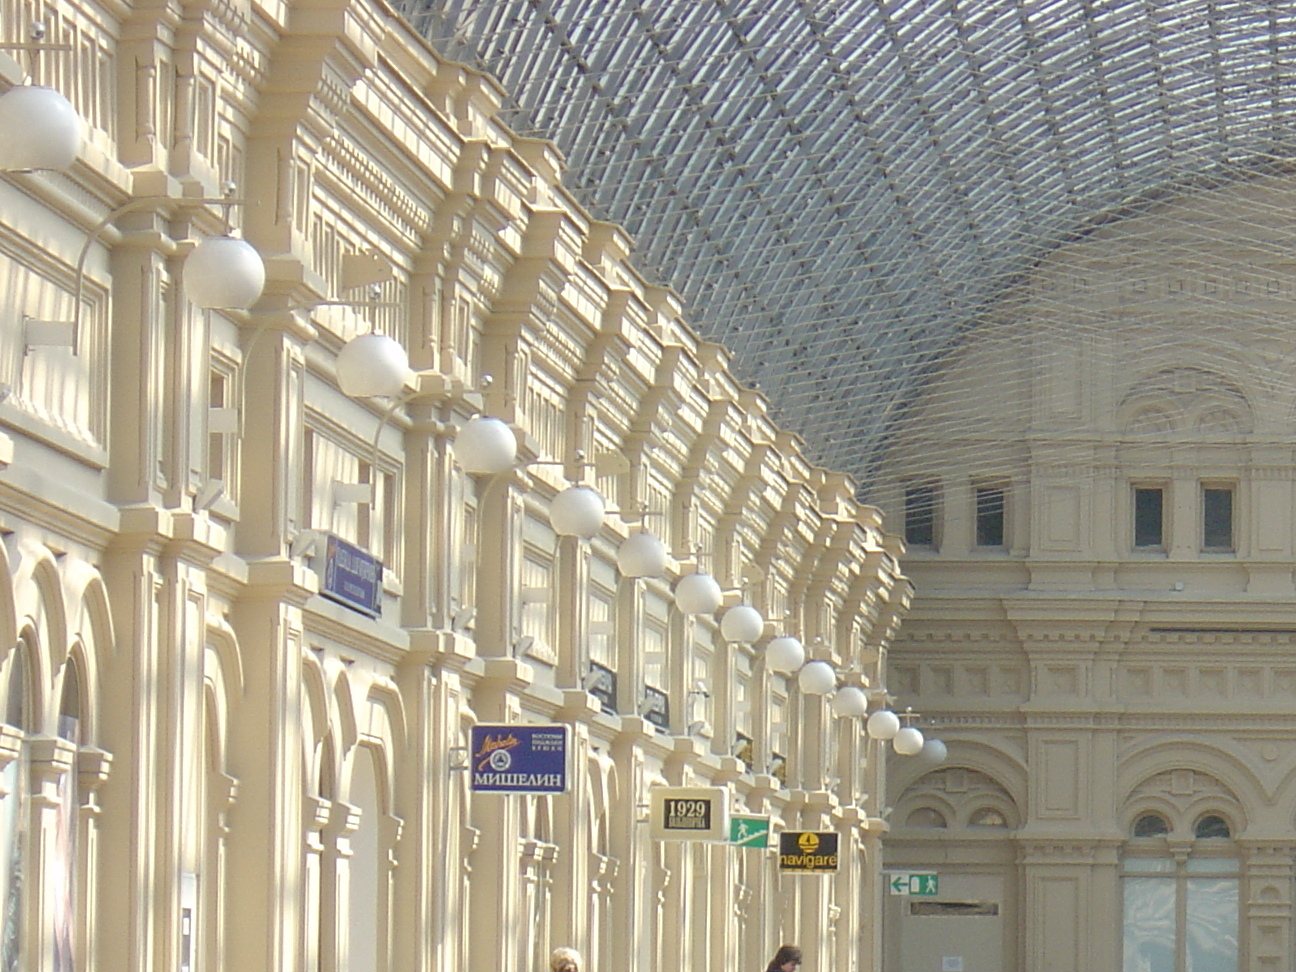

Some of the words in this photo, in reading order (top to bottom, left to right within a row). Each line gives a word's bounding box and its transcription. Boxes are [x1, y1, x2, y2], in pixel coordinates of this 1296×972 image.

[474, 773, 562, 786] МИШЕЛИН
[669, 800, 706, 817] 1929
[780, 855, 837, 868] navigare
